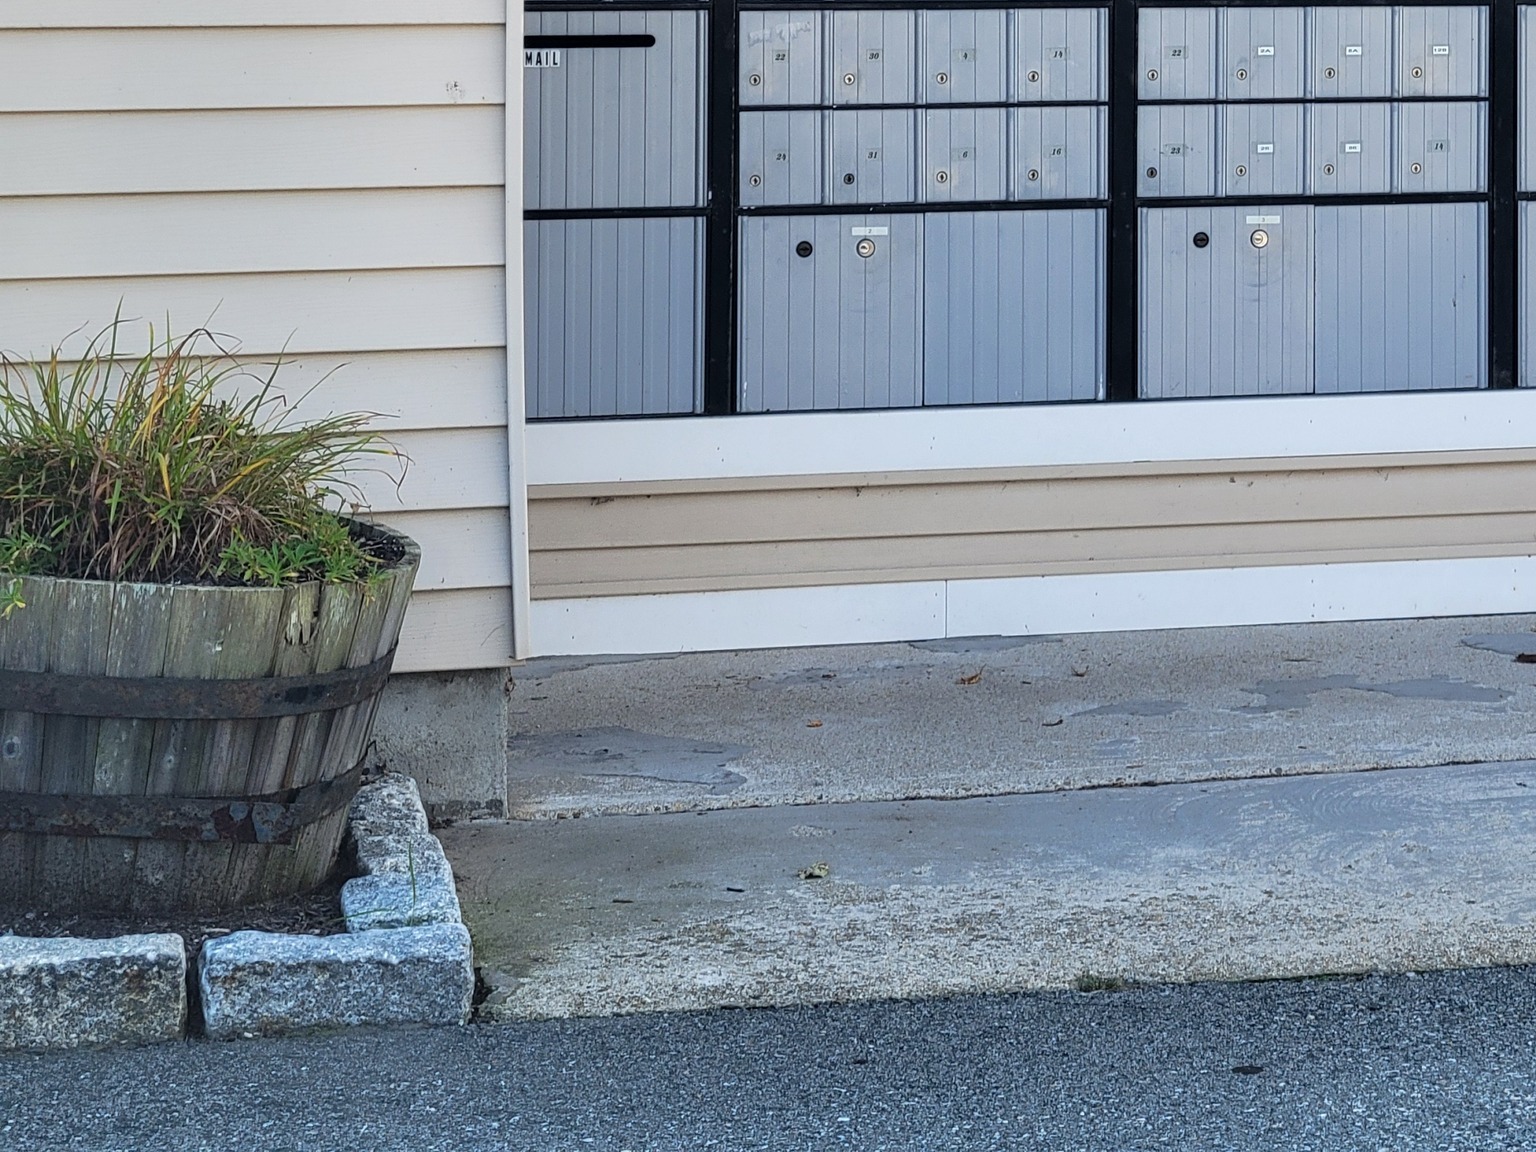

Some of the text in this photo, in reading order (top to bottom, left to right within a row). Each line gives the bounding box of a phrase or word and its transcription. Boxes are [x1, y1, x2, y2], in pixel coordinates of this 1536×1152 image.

[775, 53, 786, 61] 22
[868, 52, 880, 60] 30
[962, 51, 968, 60] 4
[1052, 50, 1064, 59] 14
[1171, 49, 1182, 57] 22
[525, 51, 559, 66] MAIL
[1170, 146, 1181, 155] 23
[1433, 142, 1445, 151] 14
[776, 152, 787, 161] 24
[867, 151, 878, 159] 31
[962, 150, 968, 159] 6
[1051, 148, 1062, 156] 16
